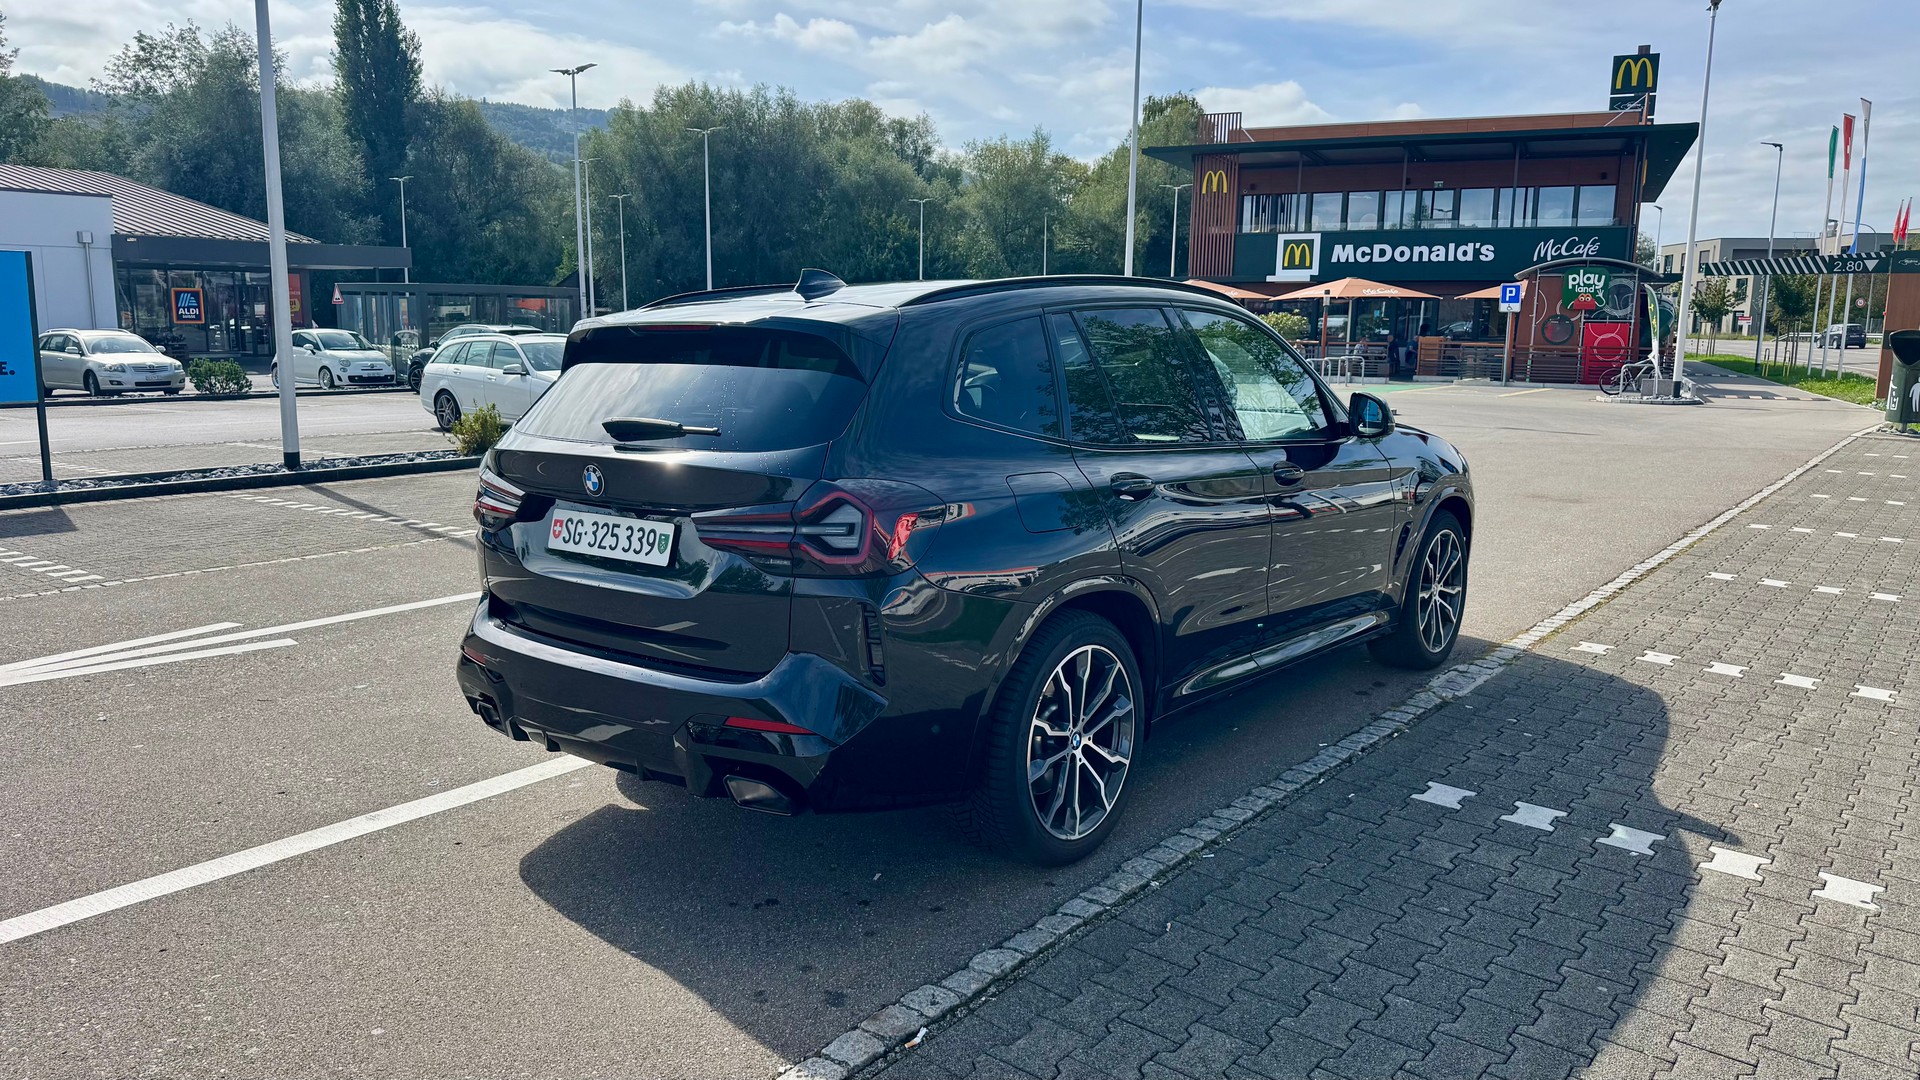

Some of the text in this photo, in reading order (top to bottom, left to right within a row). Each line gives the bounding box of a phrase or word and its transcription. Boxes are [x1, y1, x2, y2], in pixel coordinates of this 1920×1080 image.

[1331, 242, 1495, 263] McDonald's
[1533, 236, 1601, 262] McCafé
[1833, 260, 1863, 272] 2.80
[1568, 269, 1606, 290] play
[1505, 287, 1516, 302] P
[1575, 284, 1595, 293] land
[178, 307, 199, 315] ALDI
